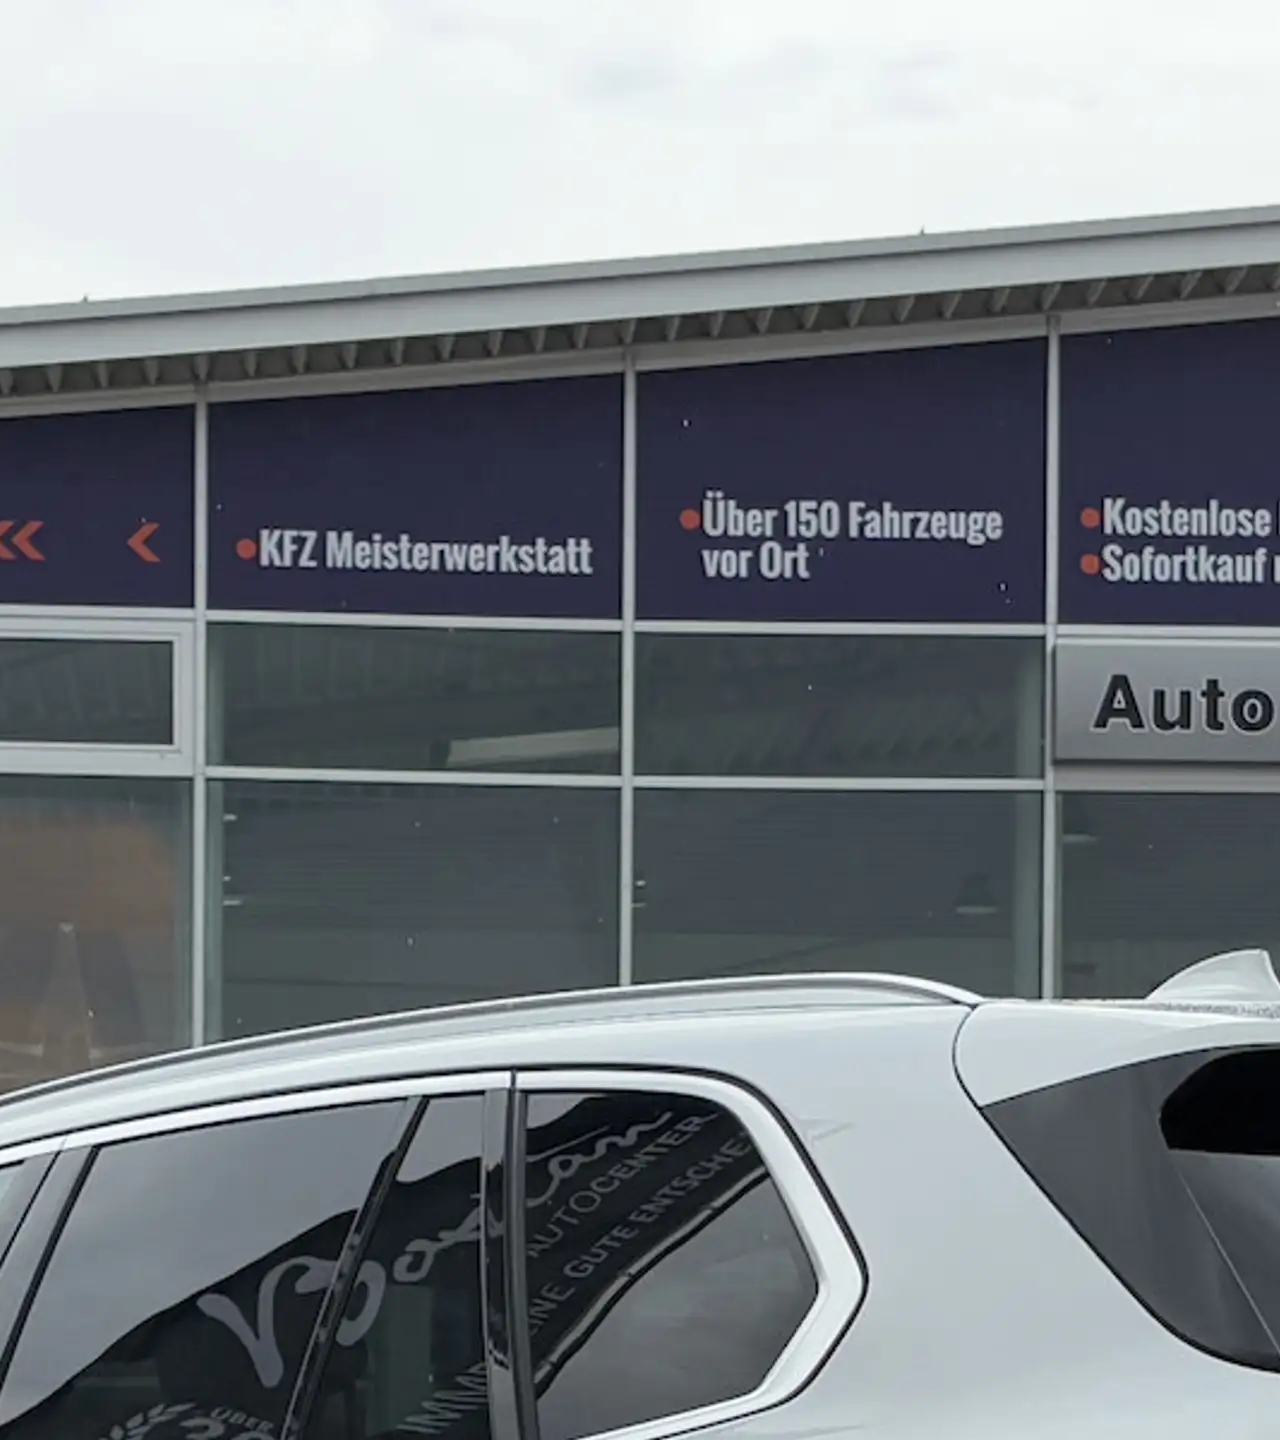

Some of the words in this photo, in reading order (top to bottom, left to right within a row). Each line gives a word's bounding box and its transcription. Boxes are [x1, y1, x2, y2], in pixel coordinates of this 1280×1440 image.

[703, 490, 777, 537] Über
[784, 501, 839, 537] 150
[848, 501, 1004, 546] Fahrzeuge
[1103, 497, 1272, 539] Kostenlose
[259, 528, 318, 568] KFZ
[326, 530, 593, 576] Meisterwerkstatt
[701, 549, 752, 578] vor
[759, 540, 810, 579] Ort
[1102, 543, 1268, 583] Sofortkauf
[1090, 671, 1276, 733] Auto
[562, 1225, 640, 1280] GUTE
[629, 1138, 752, 1223] ENTSCHE
